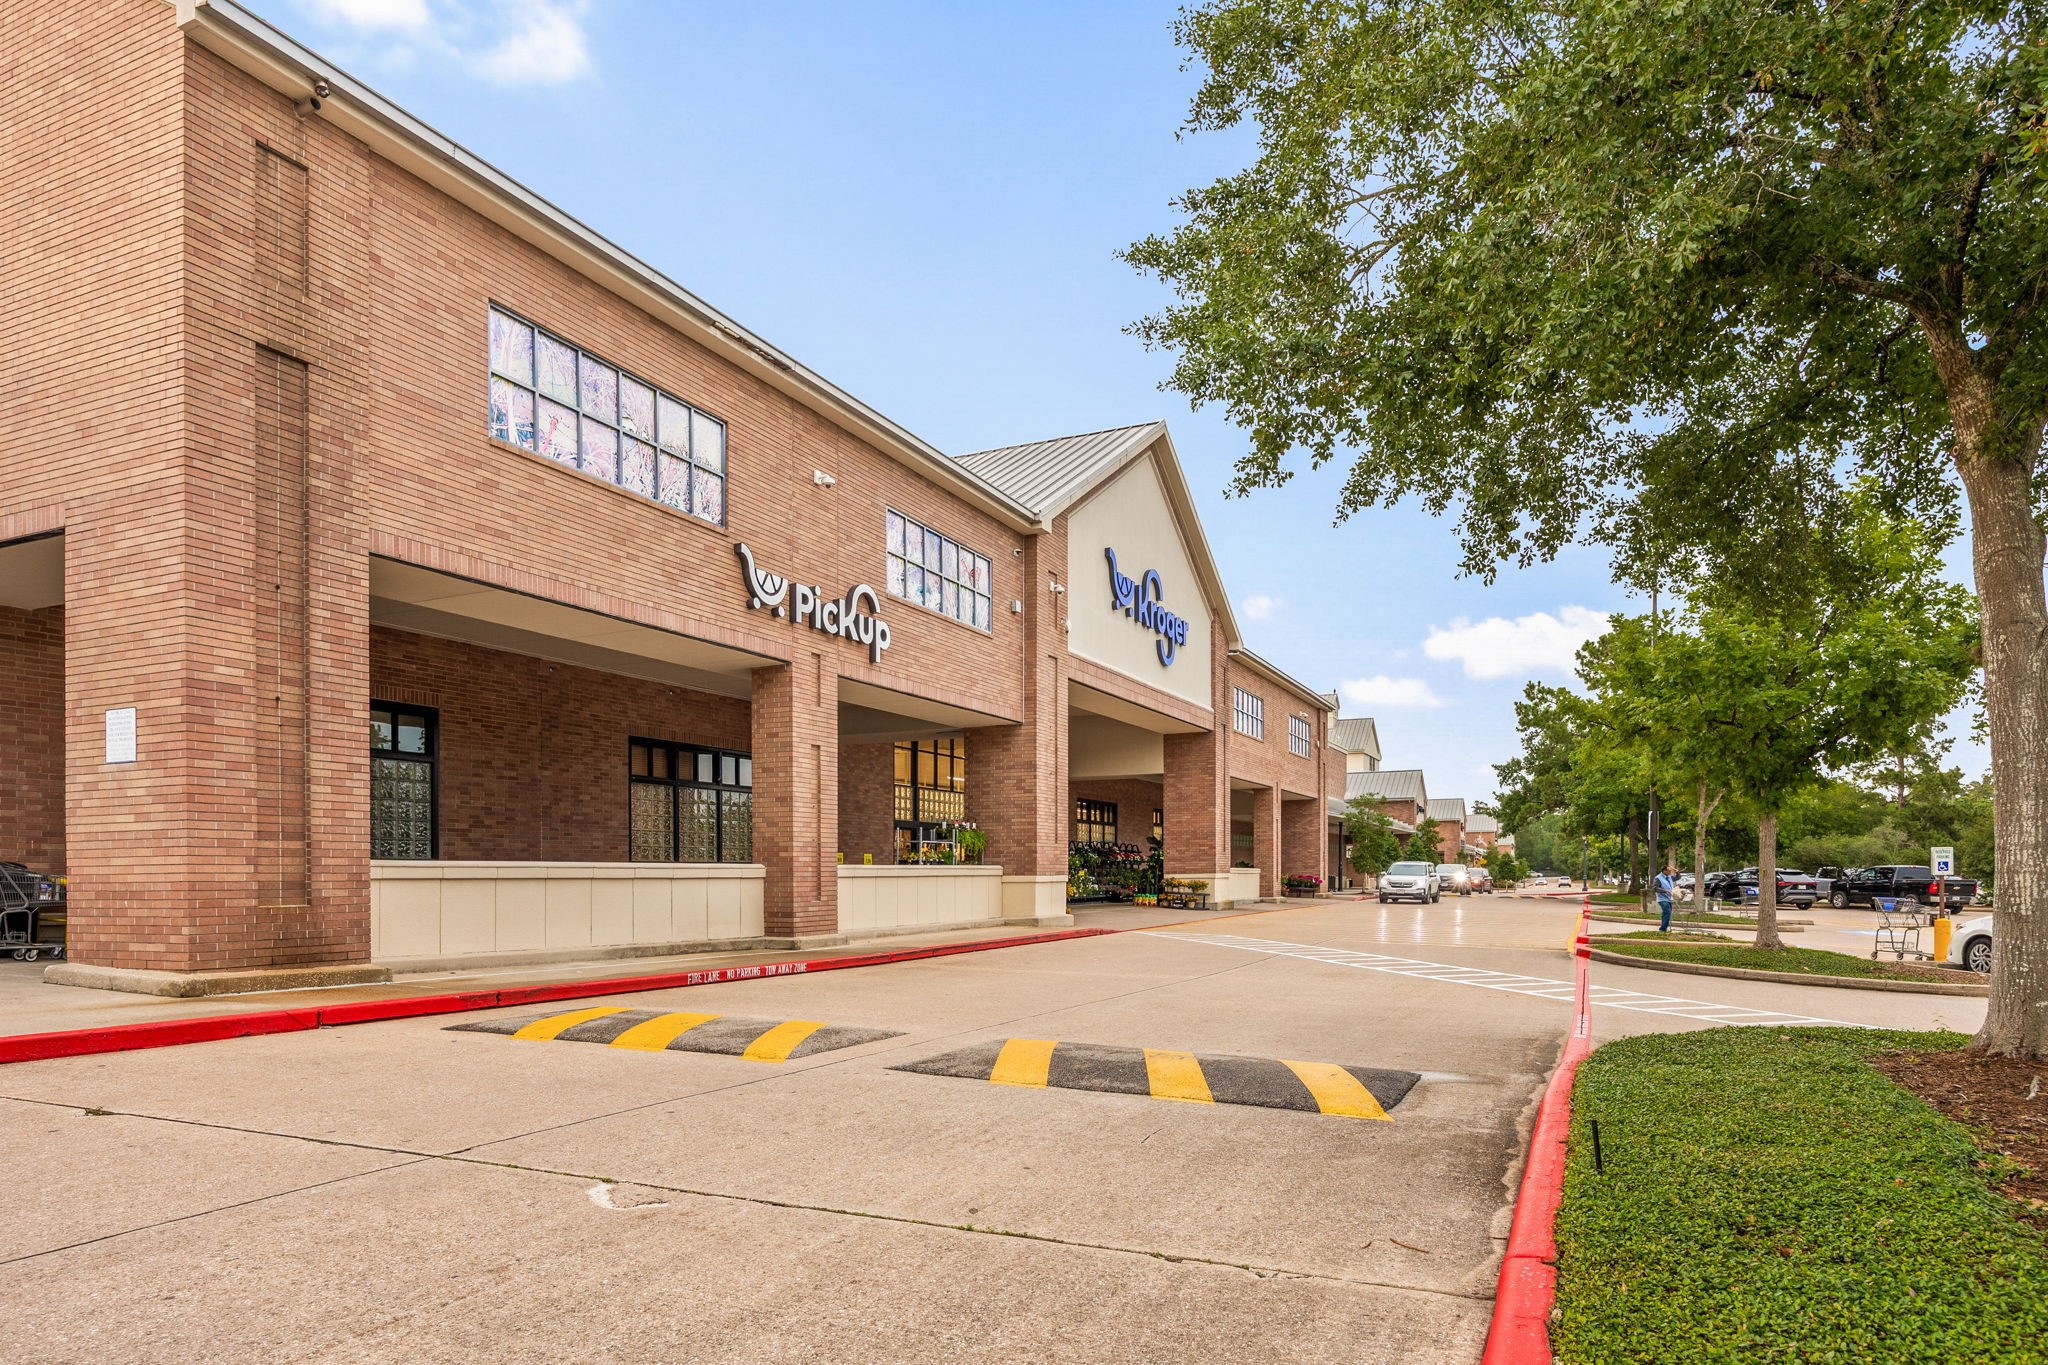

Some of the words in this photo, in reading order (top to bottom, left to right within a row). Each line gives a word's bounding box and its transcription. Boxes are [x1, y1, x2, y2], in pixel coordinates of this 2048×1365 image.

[1134, 569, 1189, 666] Kroger
[687, 973, 702, 985] FIRE
[704, 970, 720, 983] LANE
[726, 969, 735, 979] NO
[736, 966, 761, 978] PARKING
[765, 965, 777, 976] TOW
[778, 963, 793, 975] AWAY
[794, 962, 807, 973] ZONE
